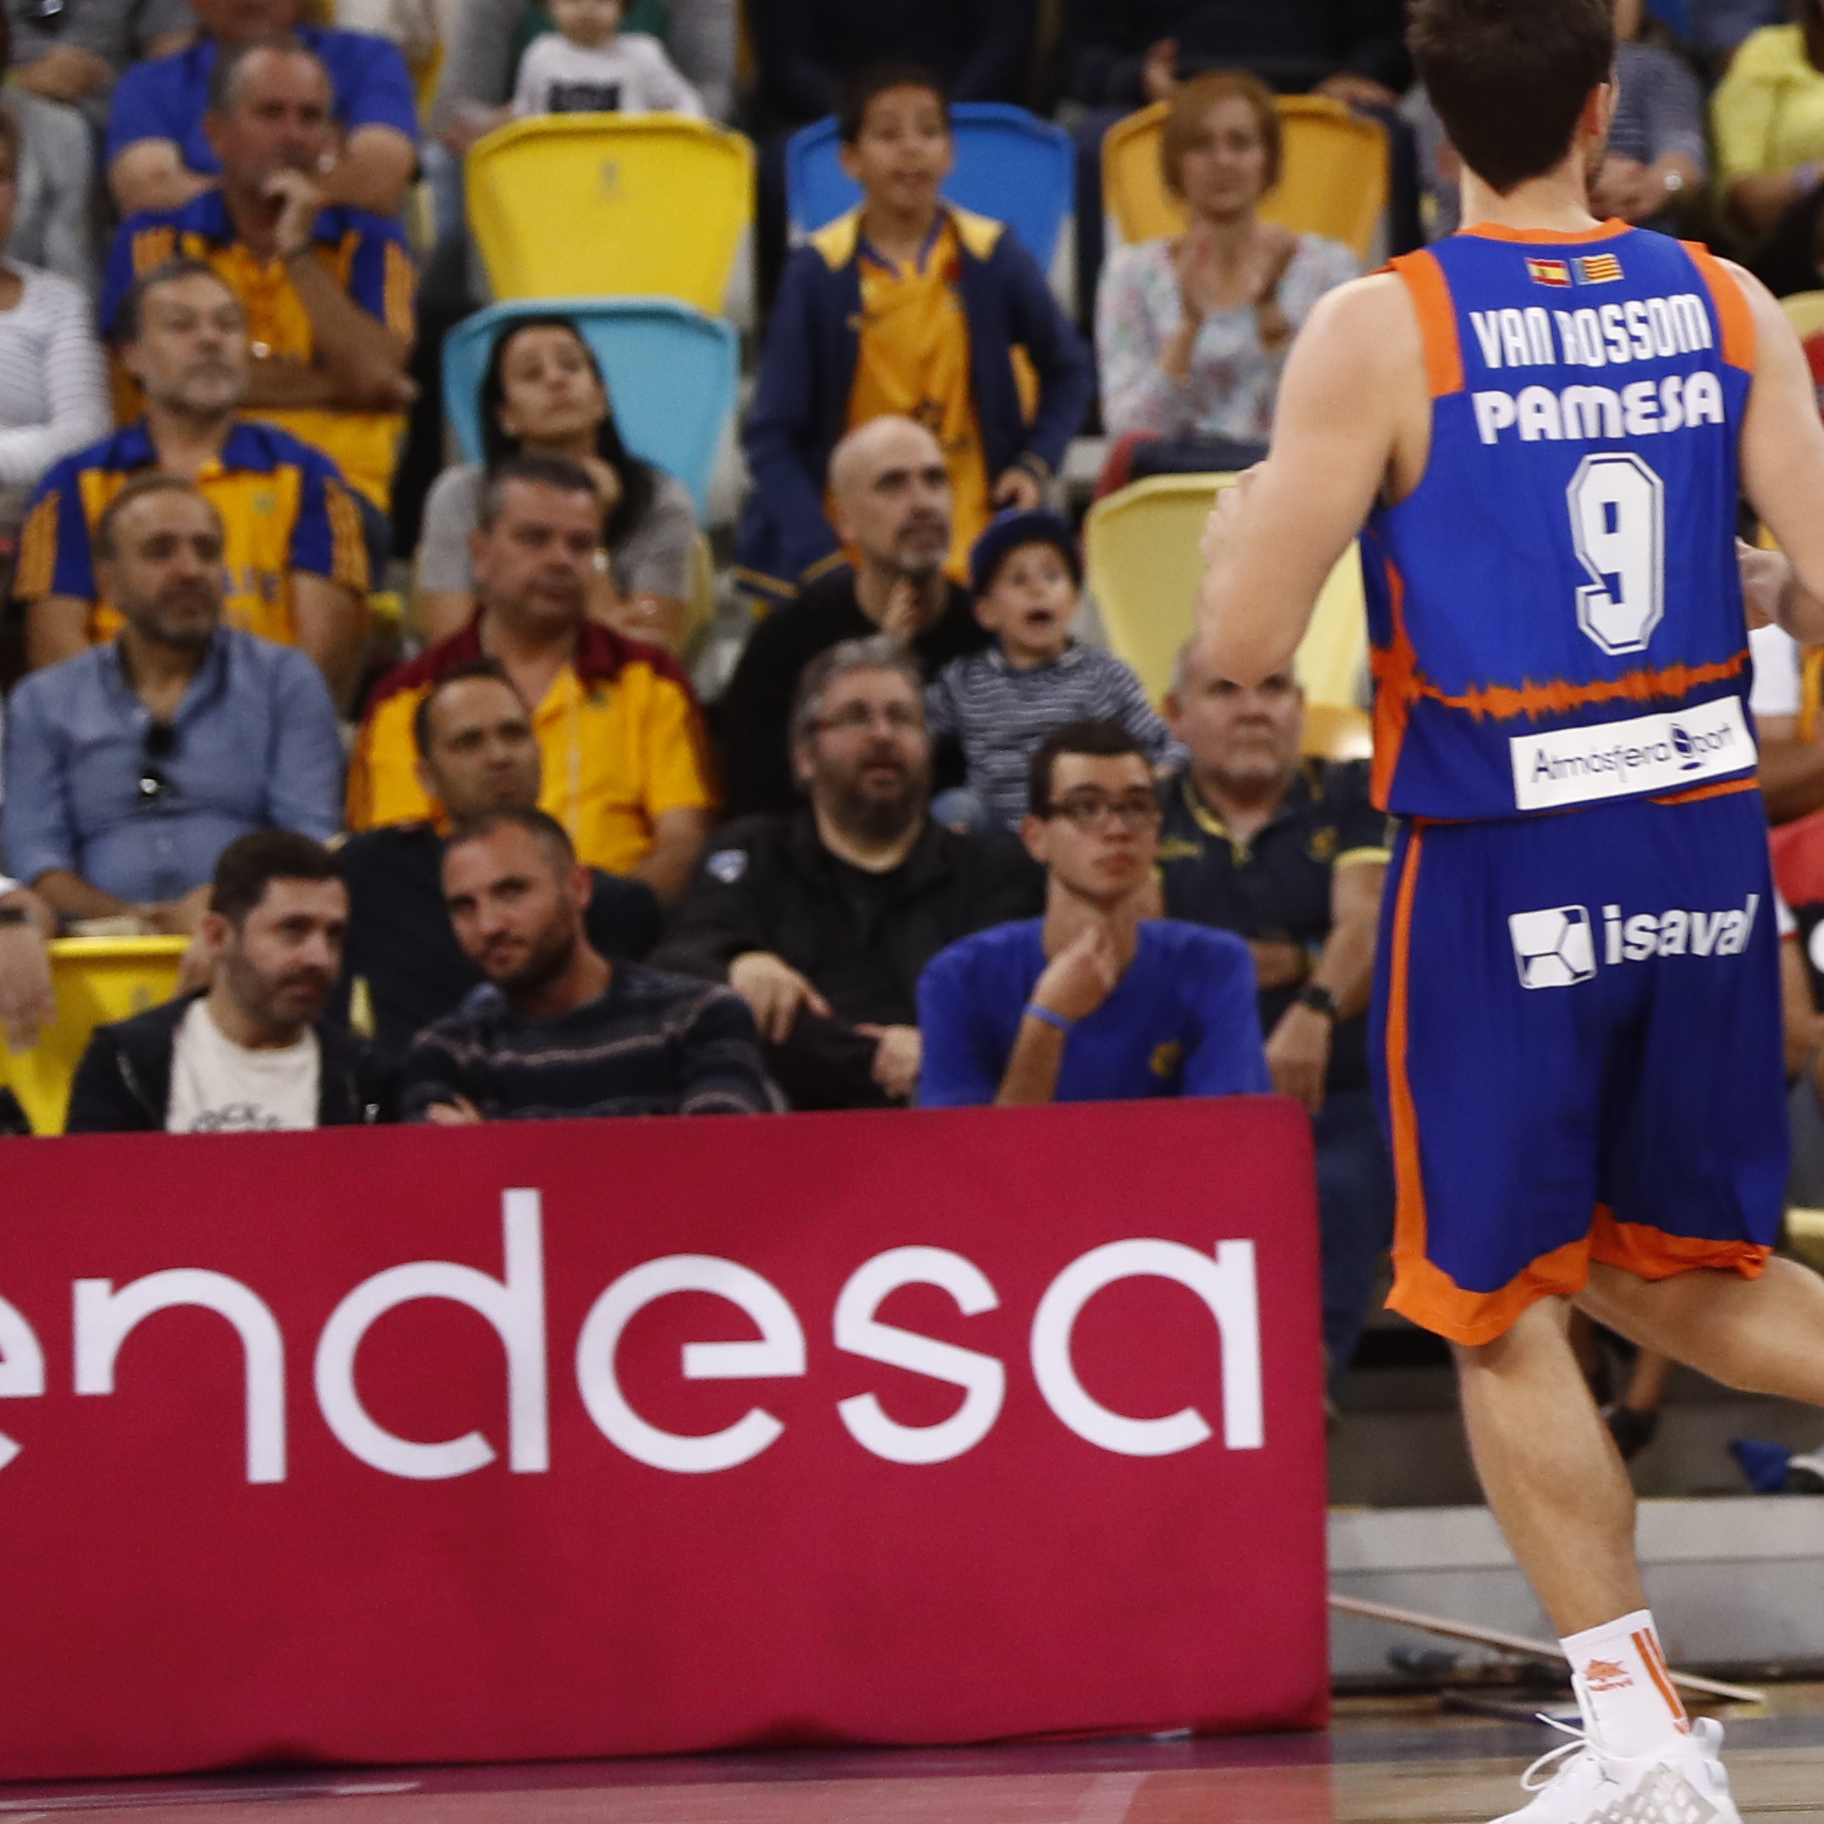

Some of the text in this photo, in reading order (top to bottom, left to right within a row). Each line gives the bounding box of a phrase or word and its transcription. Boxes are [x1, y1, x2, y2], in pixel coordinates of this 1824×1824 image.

[1469, 306, 1556, 369] VAN
[1471, 371, 1725, 446] PAMESA
[1565, 451, 1665, 656] 9
[1602, 892, 1760, 966] isaval
[0, 1187, 1265, 1484] ndesa
